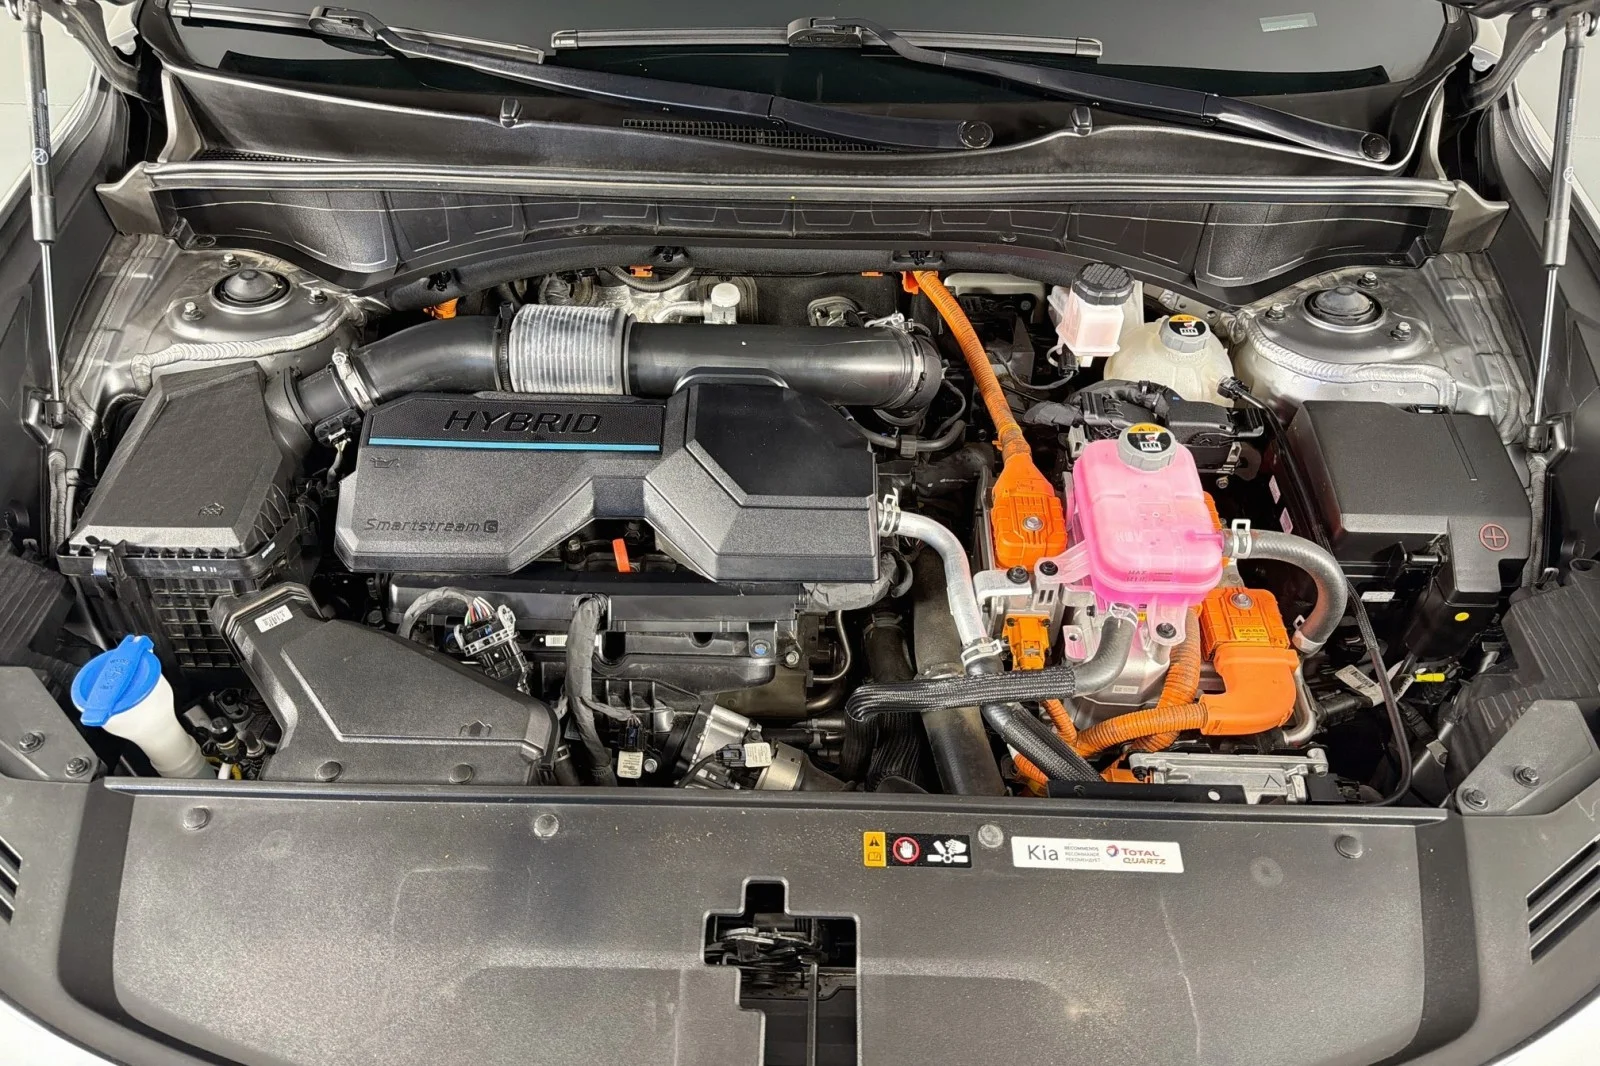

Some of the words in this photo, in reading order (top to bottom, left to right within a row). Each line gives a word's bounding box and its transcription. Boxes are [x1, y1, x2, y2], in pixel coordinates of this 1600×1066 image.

[443, 410, 602, 434] HYBRID
[364, 518, 480, 533] Smartstream
[1027, 844, 1059, 861] Kia
[1121, 848, 1160, 857] TOTAL
[1122, 857, 1166, 866] QUARTZ
